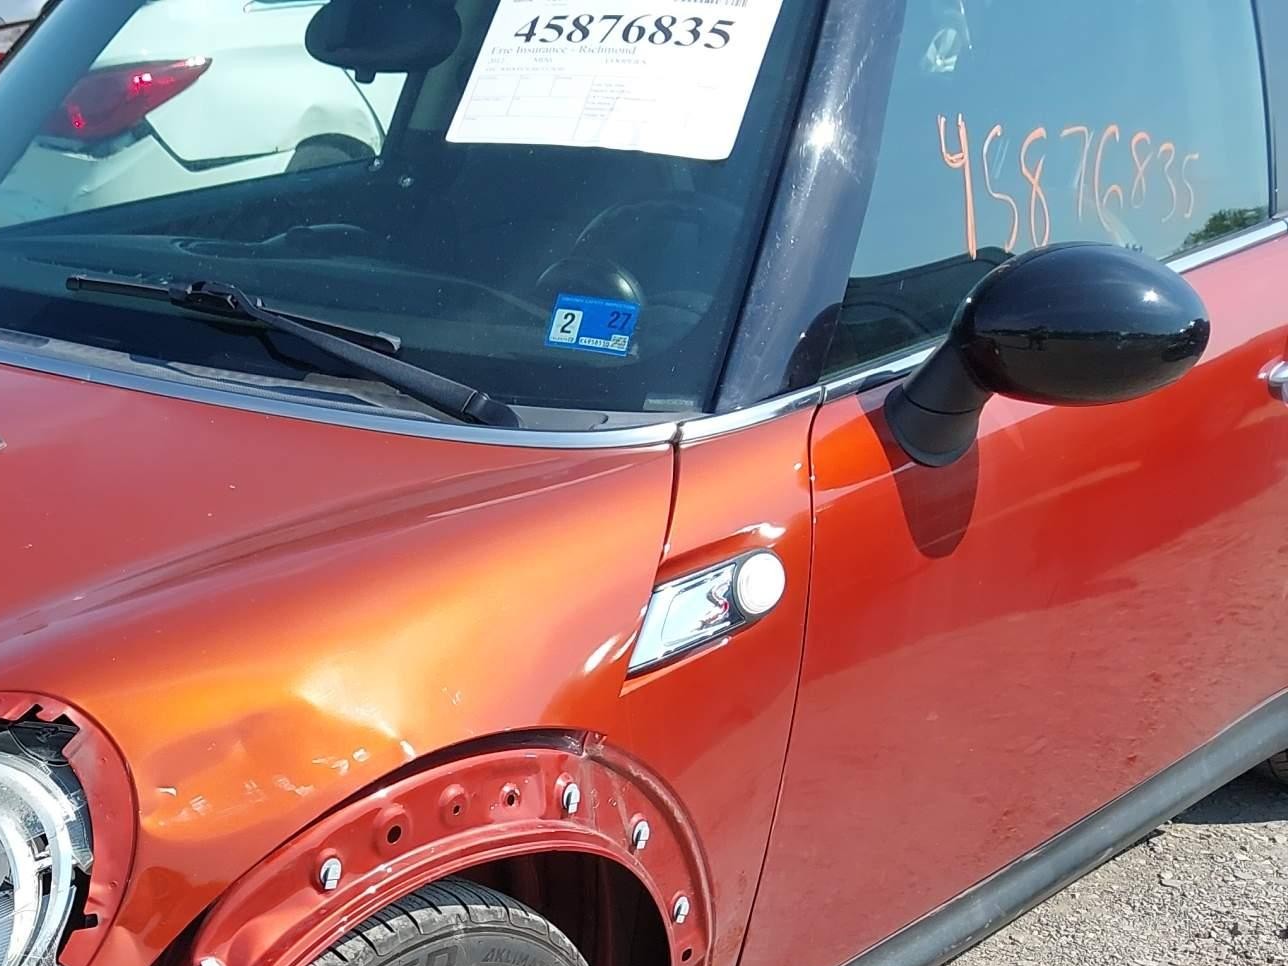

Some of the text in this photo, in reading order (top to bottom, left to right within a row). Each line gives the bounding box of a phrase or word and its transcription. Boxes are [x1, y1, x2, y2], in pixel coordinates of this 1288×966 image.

[514, 14, 736, 49] 45876835
[937, 112, 1199, 260] 45876835
[560, 311, 632, 334] 2 27
